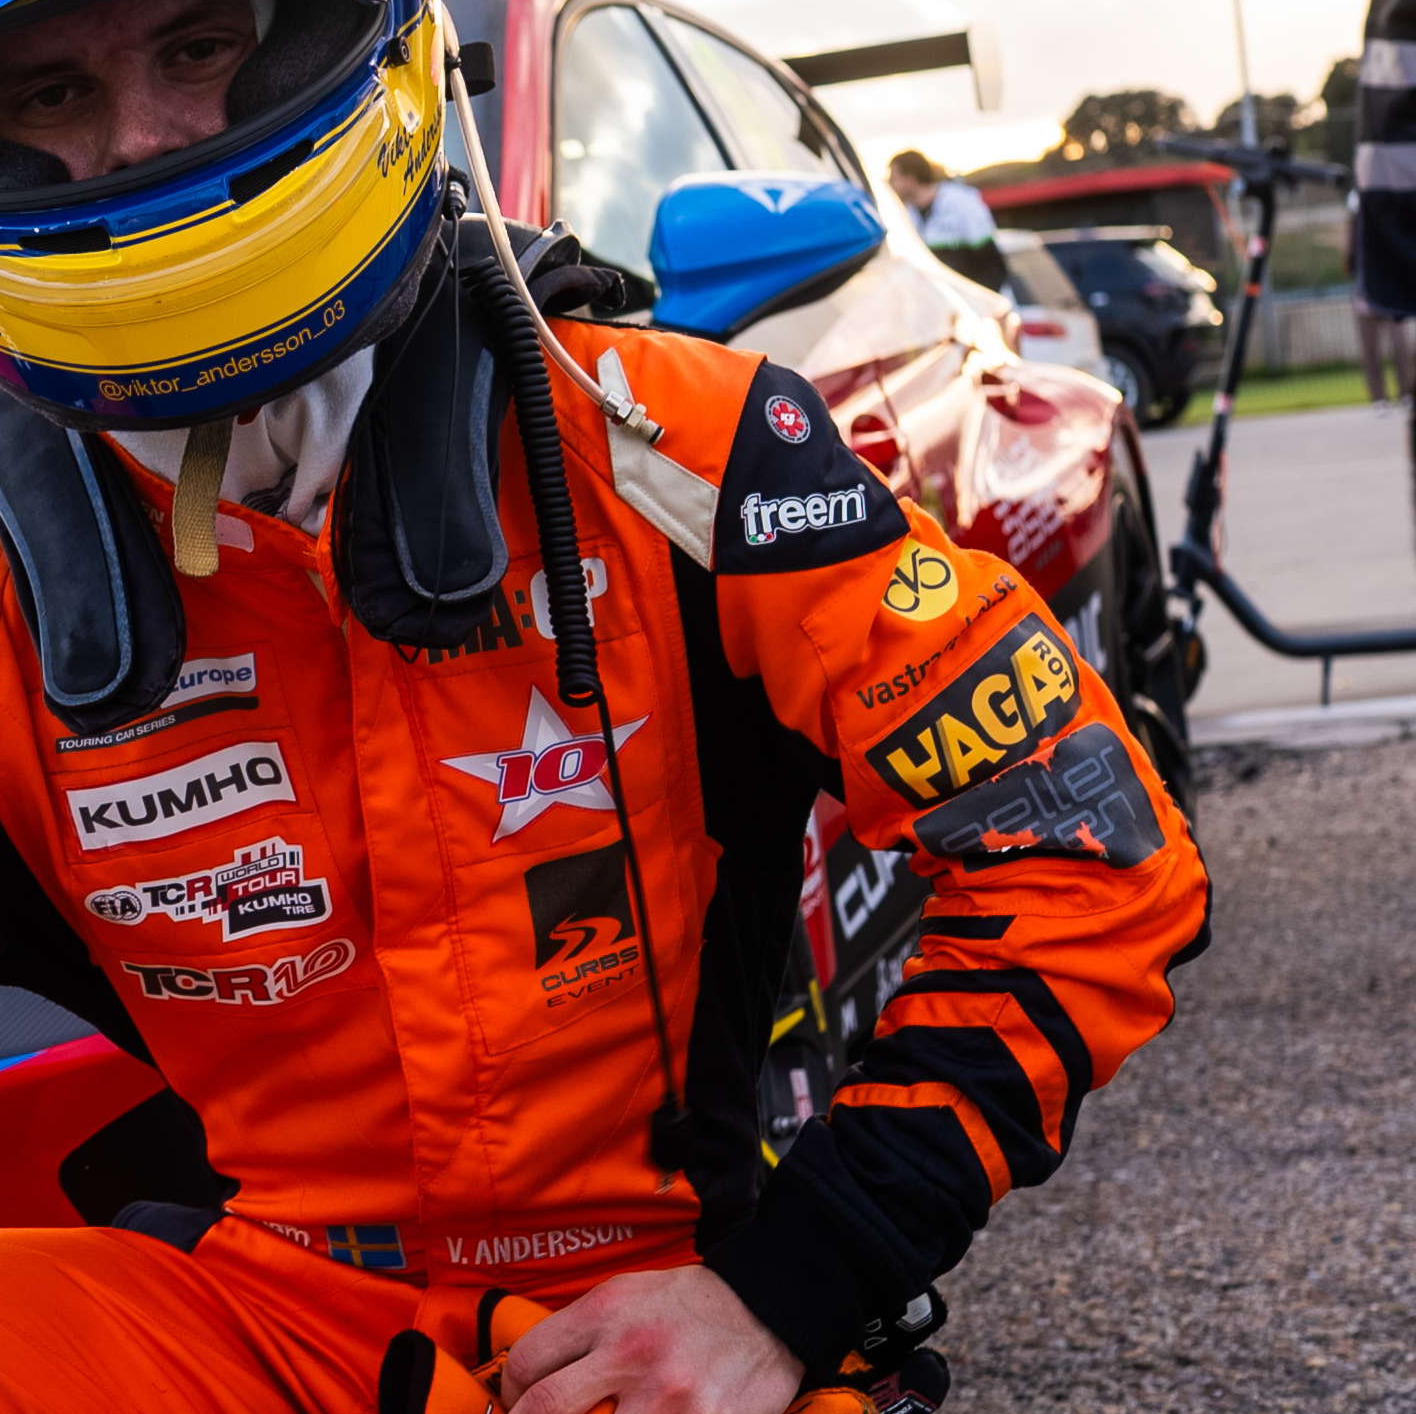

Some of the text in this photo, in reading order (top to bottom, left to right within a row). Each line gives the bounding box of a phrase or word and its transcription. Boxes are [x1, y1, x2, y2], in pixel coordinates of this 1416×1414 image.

[98, 299, 346, 401] @viktor_andersson_03
[743, 492, 864, 537] freem
[1031, 640, 1072, 690] ROT
[59, 715, 176, 751] TOURING CAR SERIES
[497, 736, 610, 805] 10
[79, 756, 283, 834] KUMHO
[220, 856, 281, 881] WORLD
[232, 870, 298, 893] TOUR
[142, 874, 215, 908] TCR
[237, 892, 312, 915] KUMHO
[282, 904, 316, 916] TIRE
[541, 945, 640, 992] CURBS
[547, 963, 641, 1008] EVENT
[446, 1225, 634, 1265] V. ANDERSSON
